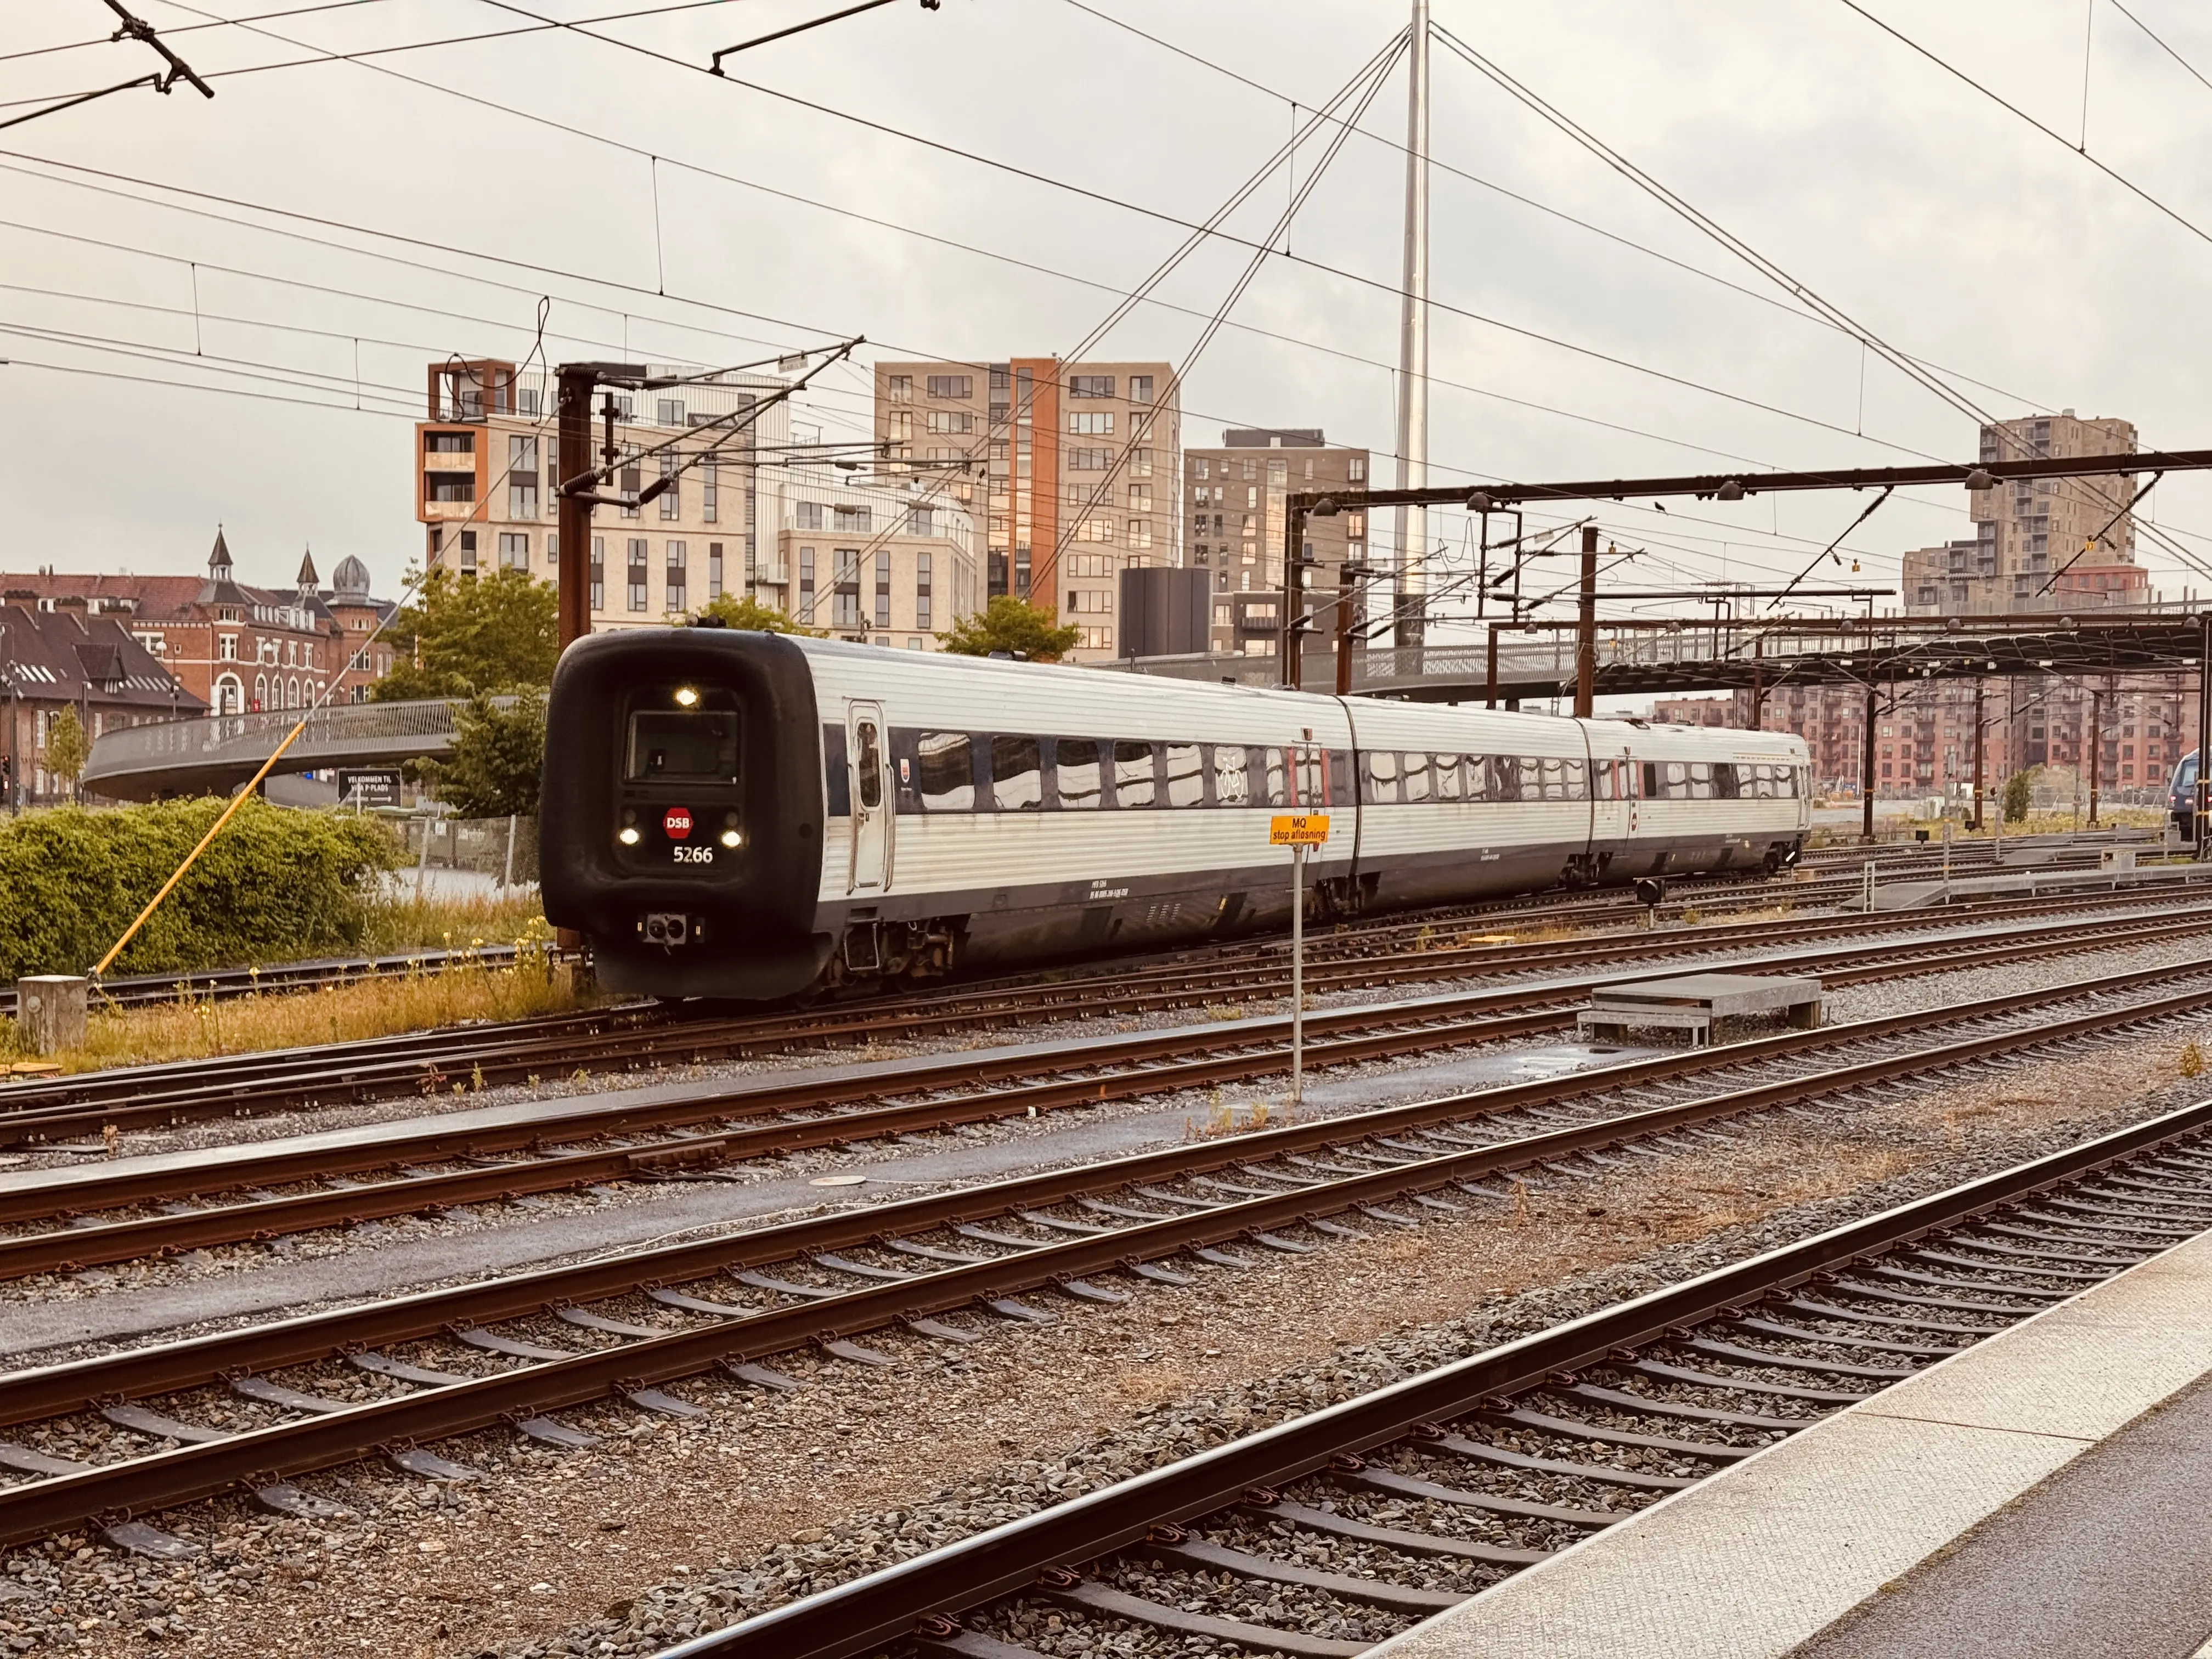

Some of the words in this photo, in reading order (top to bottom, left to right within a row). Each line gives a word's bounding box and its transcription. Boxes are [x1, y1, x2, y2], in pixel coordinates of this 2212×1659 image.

[348, 775, 382, 783] VELKOMMEN
[351, 784, 364, 792] VIA
[667, 817, 690, 828] DSB
[1292, 818, 1306, 828] MQ
[1273, 830, 1289, 842] stop
[674, 846, 713, 863] 5266
